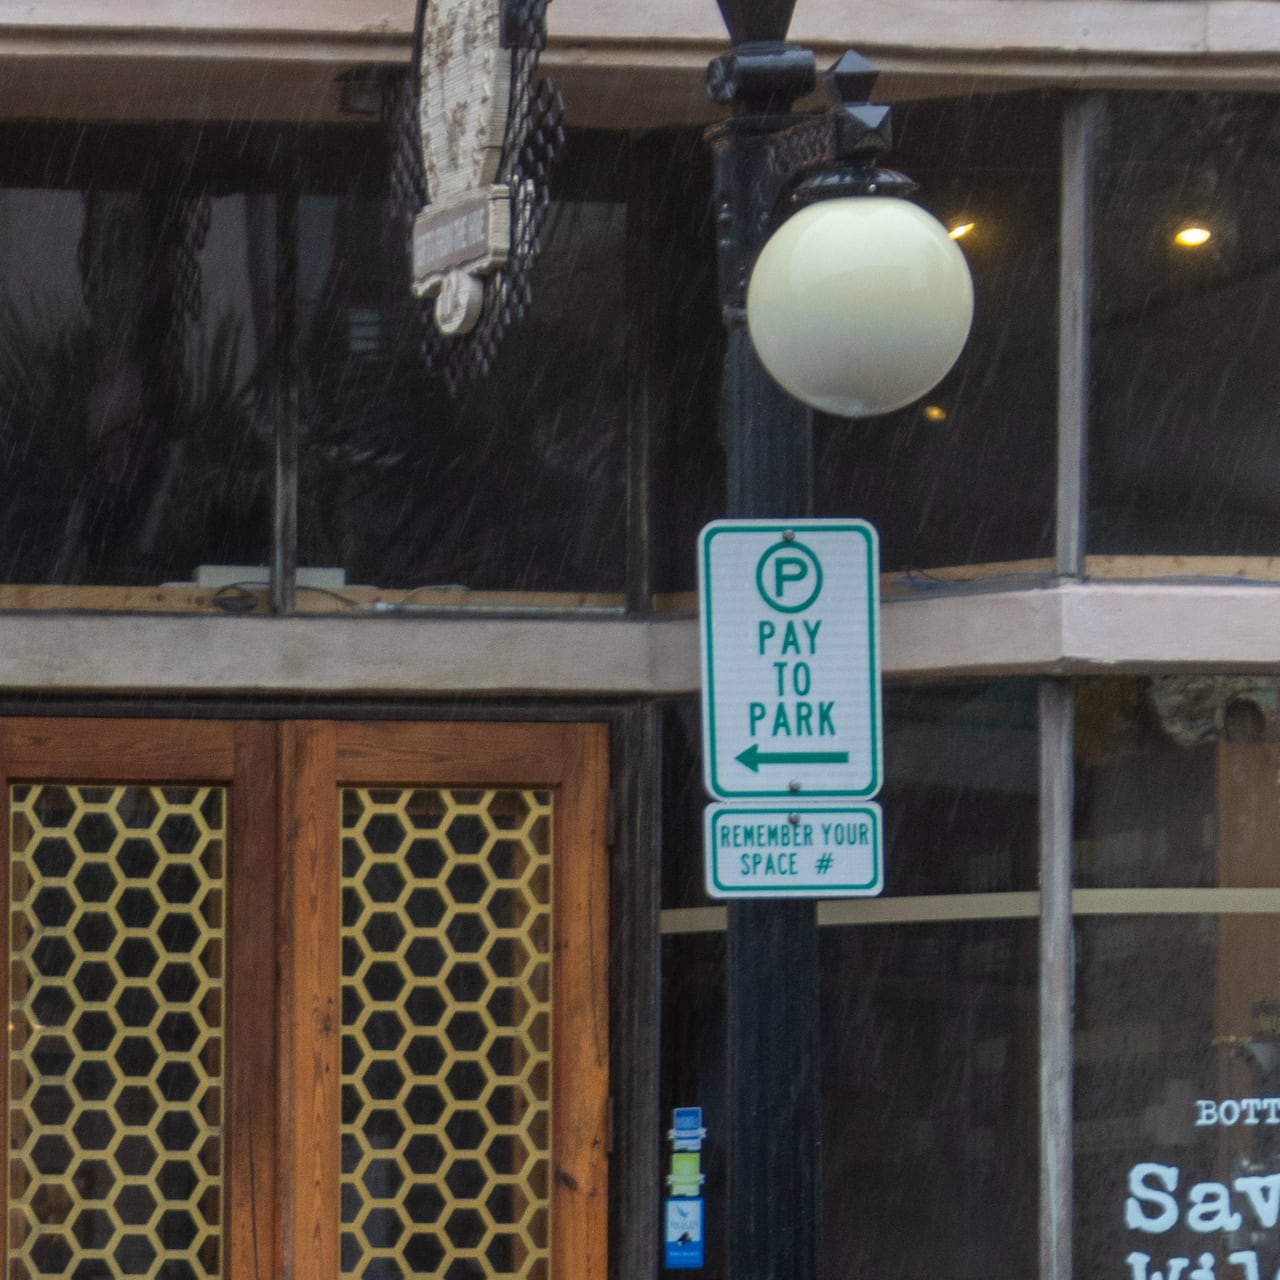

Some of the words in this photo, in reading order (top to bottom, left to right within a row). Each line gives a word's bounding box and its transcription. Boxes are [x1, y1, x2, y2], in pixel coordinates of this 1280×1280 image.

[774, 557, 808, 598] P
[759, 620, 822, 655] PAY
[773, 661, 811, 697] TO
[750, 701, 837, 737] PARK
[721, 824, 813, 848] REMEMBER
[823, 823, 870, 847] YOUR
[741, 853, 798, 876] SPACE
[815, 852, 834, 875] #
